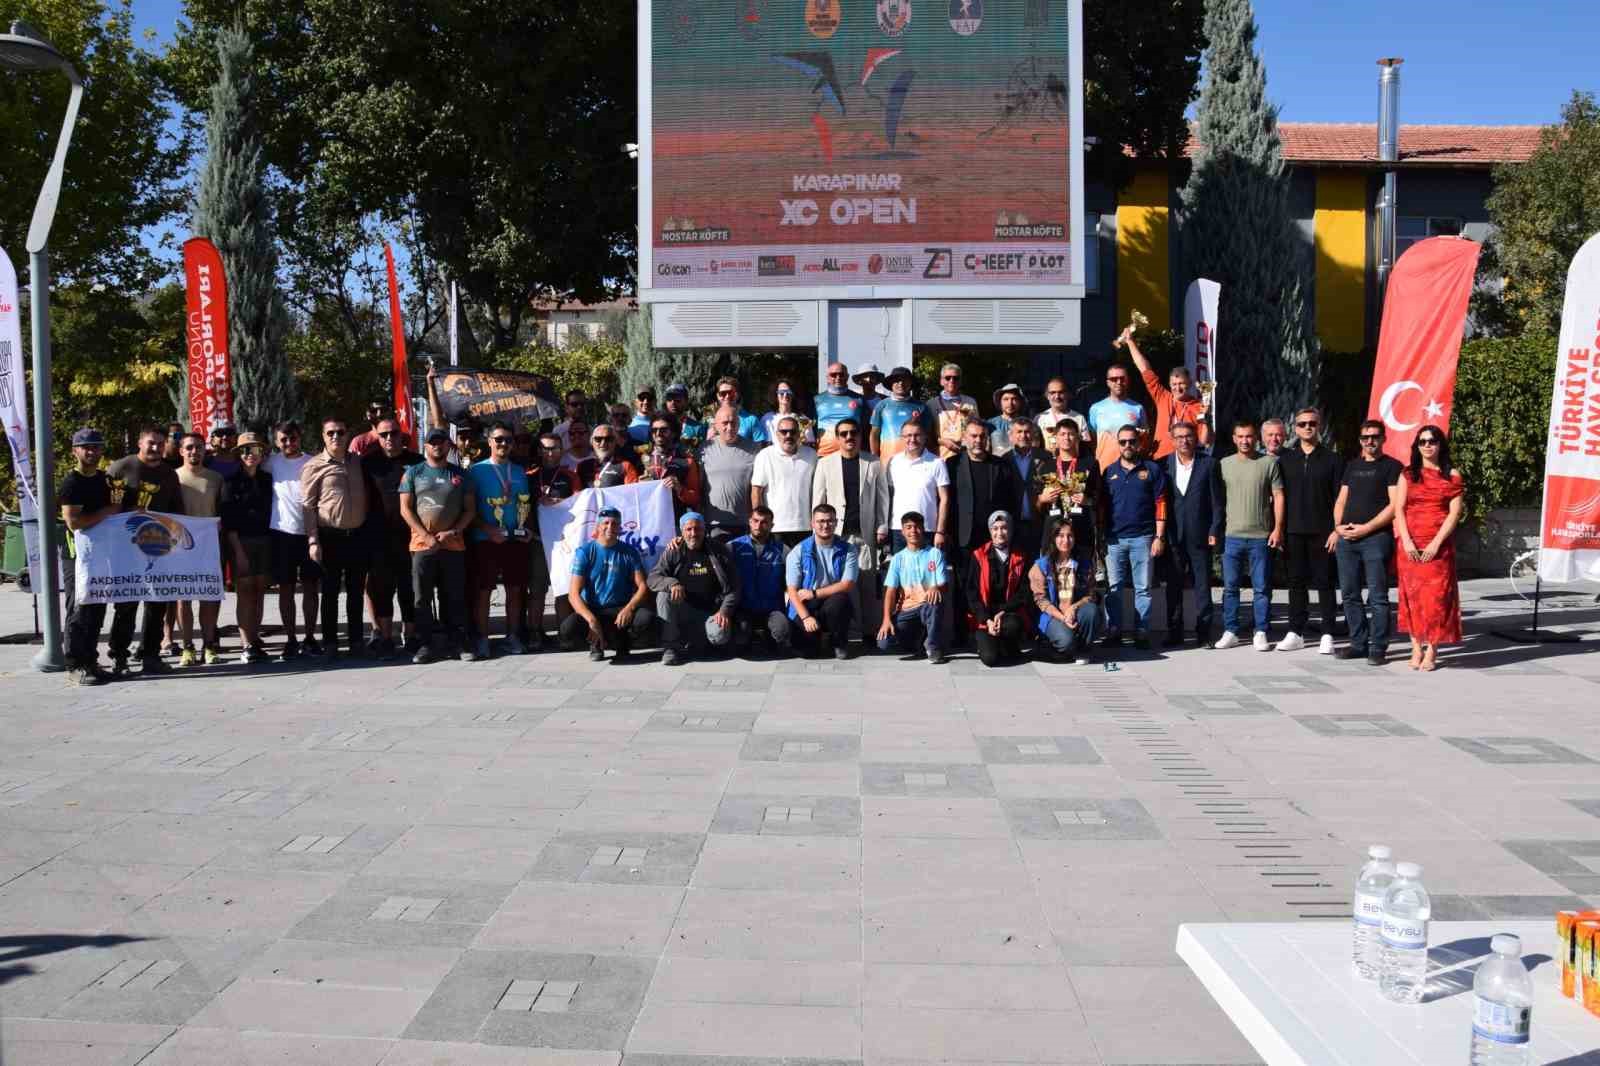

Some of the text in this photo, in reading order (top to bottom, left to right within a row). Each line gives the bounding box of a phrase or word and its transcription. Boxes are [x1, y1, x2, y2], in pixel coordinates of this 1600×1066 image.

[792, 173, 902, 192] KARAPINAR
[778, 198, 917, 226] XC OPEN
[661, 231, 698, 242] MOSTAR
[994, 224, 1063, 238] MOSTAR KÖFTE
[1553, 347, 1590, 455] TÜRKİYE
[90, 572, 142, 585] AKDENİZ
[90, 587, 151, 599] HAVACILIK
